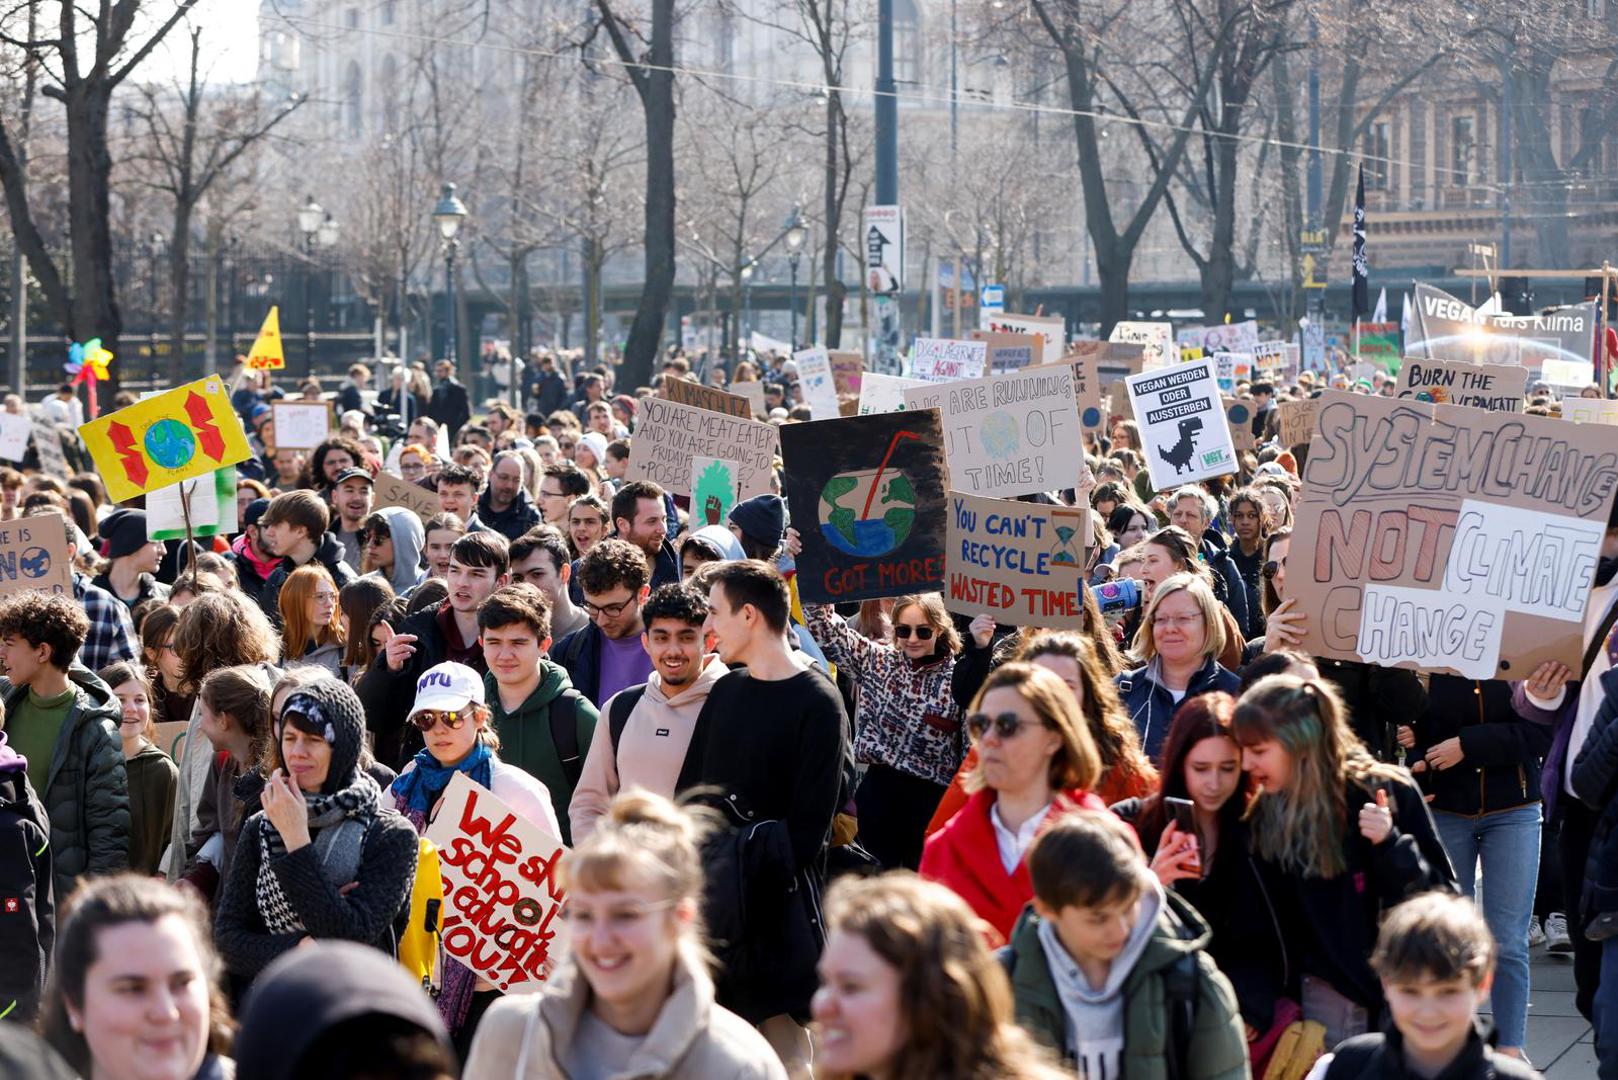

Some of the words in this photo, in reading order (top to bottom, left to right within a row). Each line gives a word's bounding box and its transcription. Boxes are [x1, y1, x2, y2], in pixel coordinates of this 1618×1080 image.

[1424, 295, 1486, 325] VEGAN
[950, 385, 988, 416] ARE
[992, 374, 1072, 408] RUNNING
[1135, 377, 1167, 394] VEGAN
[1167, 368, 1207, 388] WERDEN
[1162, 389, 1188, 403] ODER
[1408, 364, 1457, 388] BURN
[1461, 372, 1496, 391] THE
[644, 401, 669, 425] YOU
[670, 409, 697, 432] ARE
[698, 415, 738, 442] MEAT
[736, 423, 776, 449] EATER
[1025, 407, 1069, 448] OF
[1149, 399, 1209, 423] AUSSTERBEN
[638, 422, 667, 443] AND
[668, 429, 688, 449] YOU
[687, 437, 714, 457] ARE
[717, 444, 754, 465] GOING
[754, 452, 770, 471] TO
[1304, 402, 1494, 507] SYSTEM
[1481, 422, 1617, 517] CHANGE
[964, 455, 1045, 491] TIME!
[384, 485, 432, 517] SAVE
[953, 498, 977, 533] YOU
[984, 514, 1047, 539] CAN'T
[18, 528, 32, 543] IS
[961, 539, 1051, 576] RECYCLE
[1313, 503, 1461, 583] NOT
[1446, 511, 1601, 612] CLIMATE
[823, 562, 869, 597] GOT
[950, 572, 1016, 610] WASTED
[1020, 576, 1084, 618] TIME!
[1320, 585, 1496, 662] CHANGE
[416, 671, 453, 694] NYU
[458, 789, 523, 866] We
[437, 836, 560, 941] school
